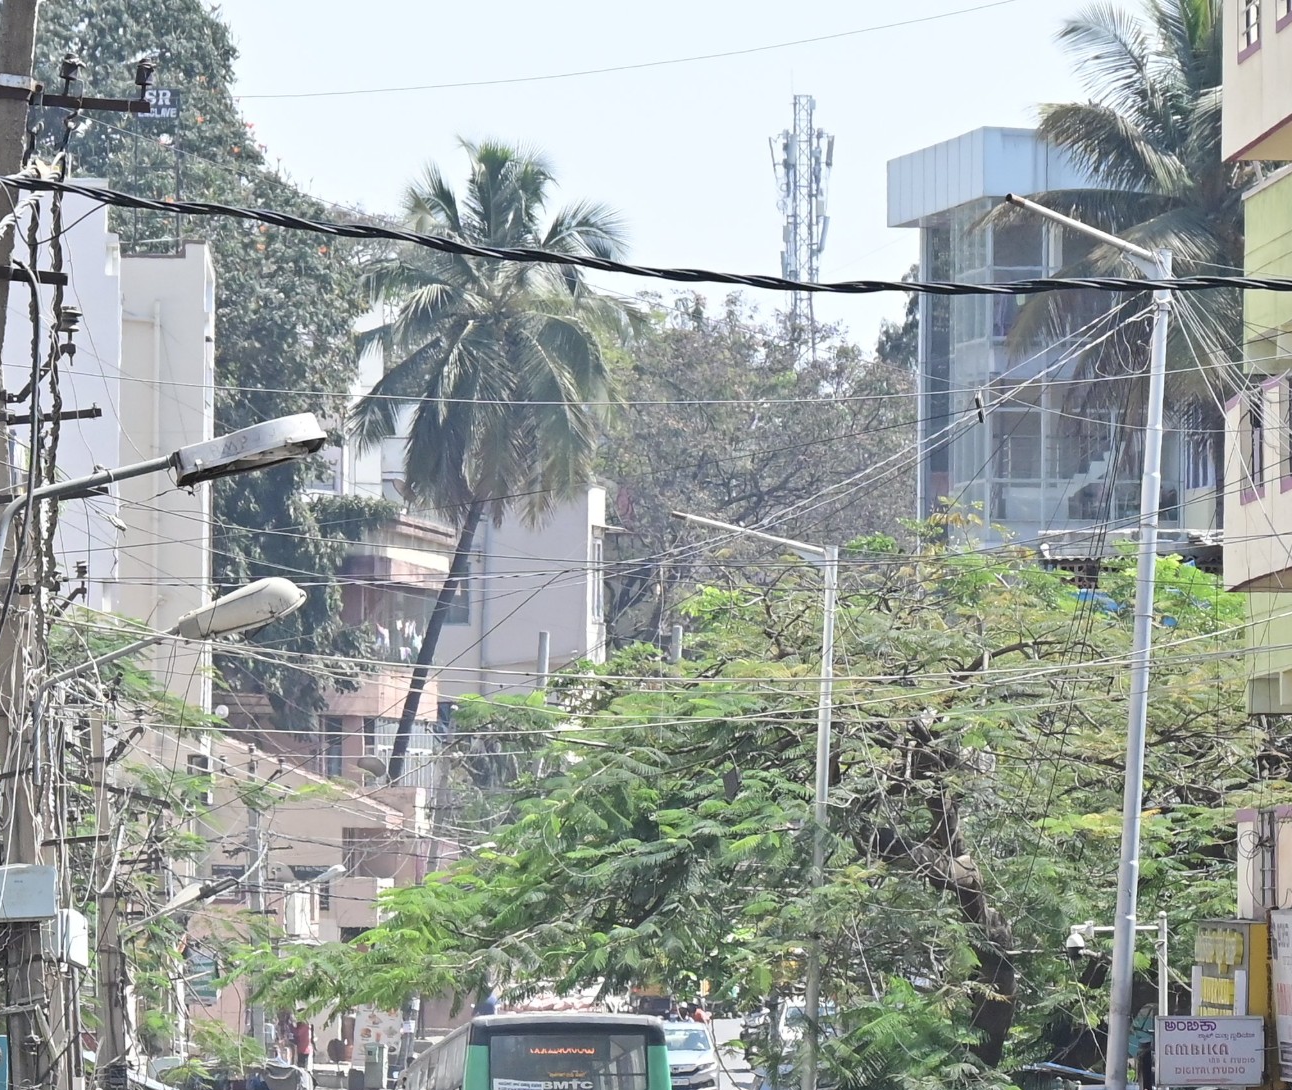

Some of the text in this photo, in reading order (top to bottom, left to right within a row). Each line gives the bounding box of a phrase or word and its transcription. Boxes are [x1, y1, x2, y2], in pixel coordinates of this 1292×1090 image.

[1164, 1043, 1229, 1055] AMBIKA
[1175, 1066, 1246, 1075] DIGITAL STUDIO
[542, 1080, 593, 1090] BMTC
